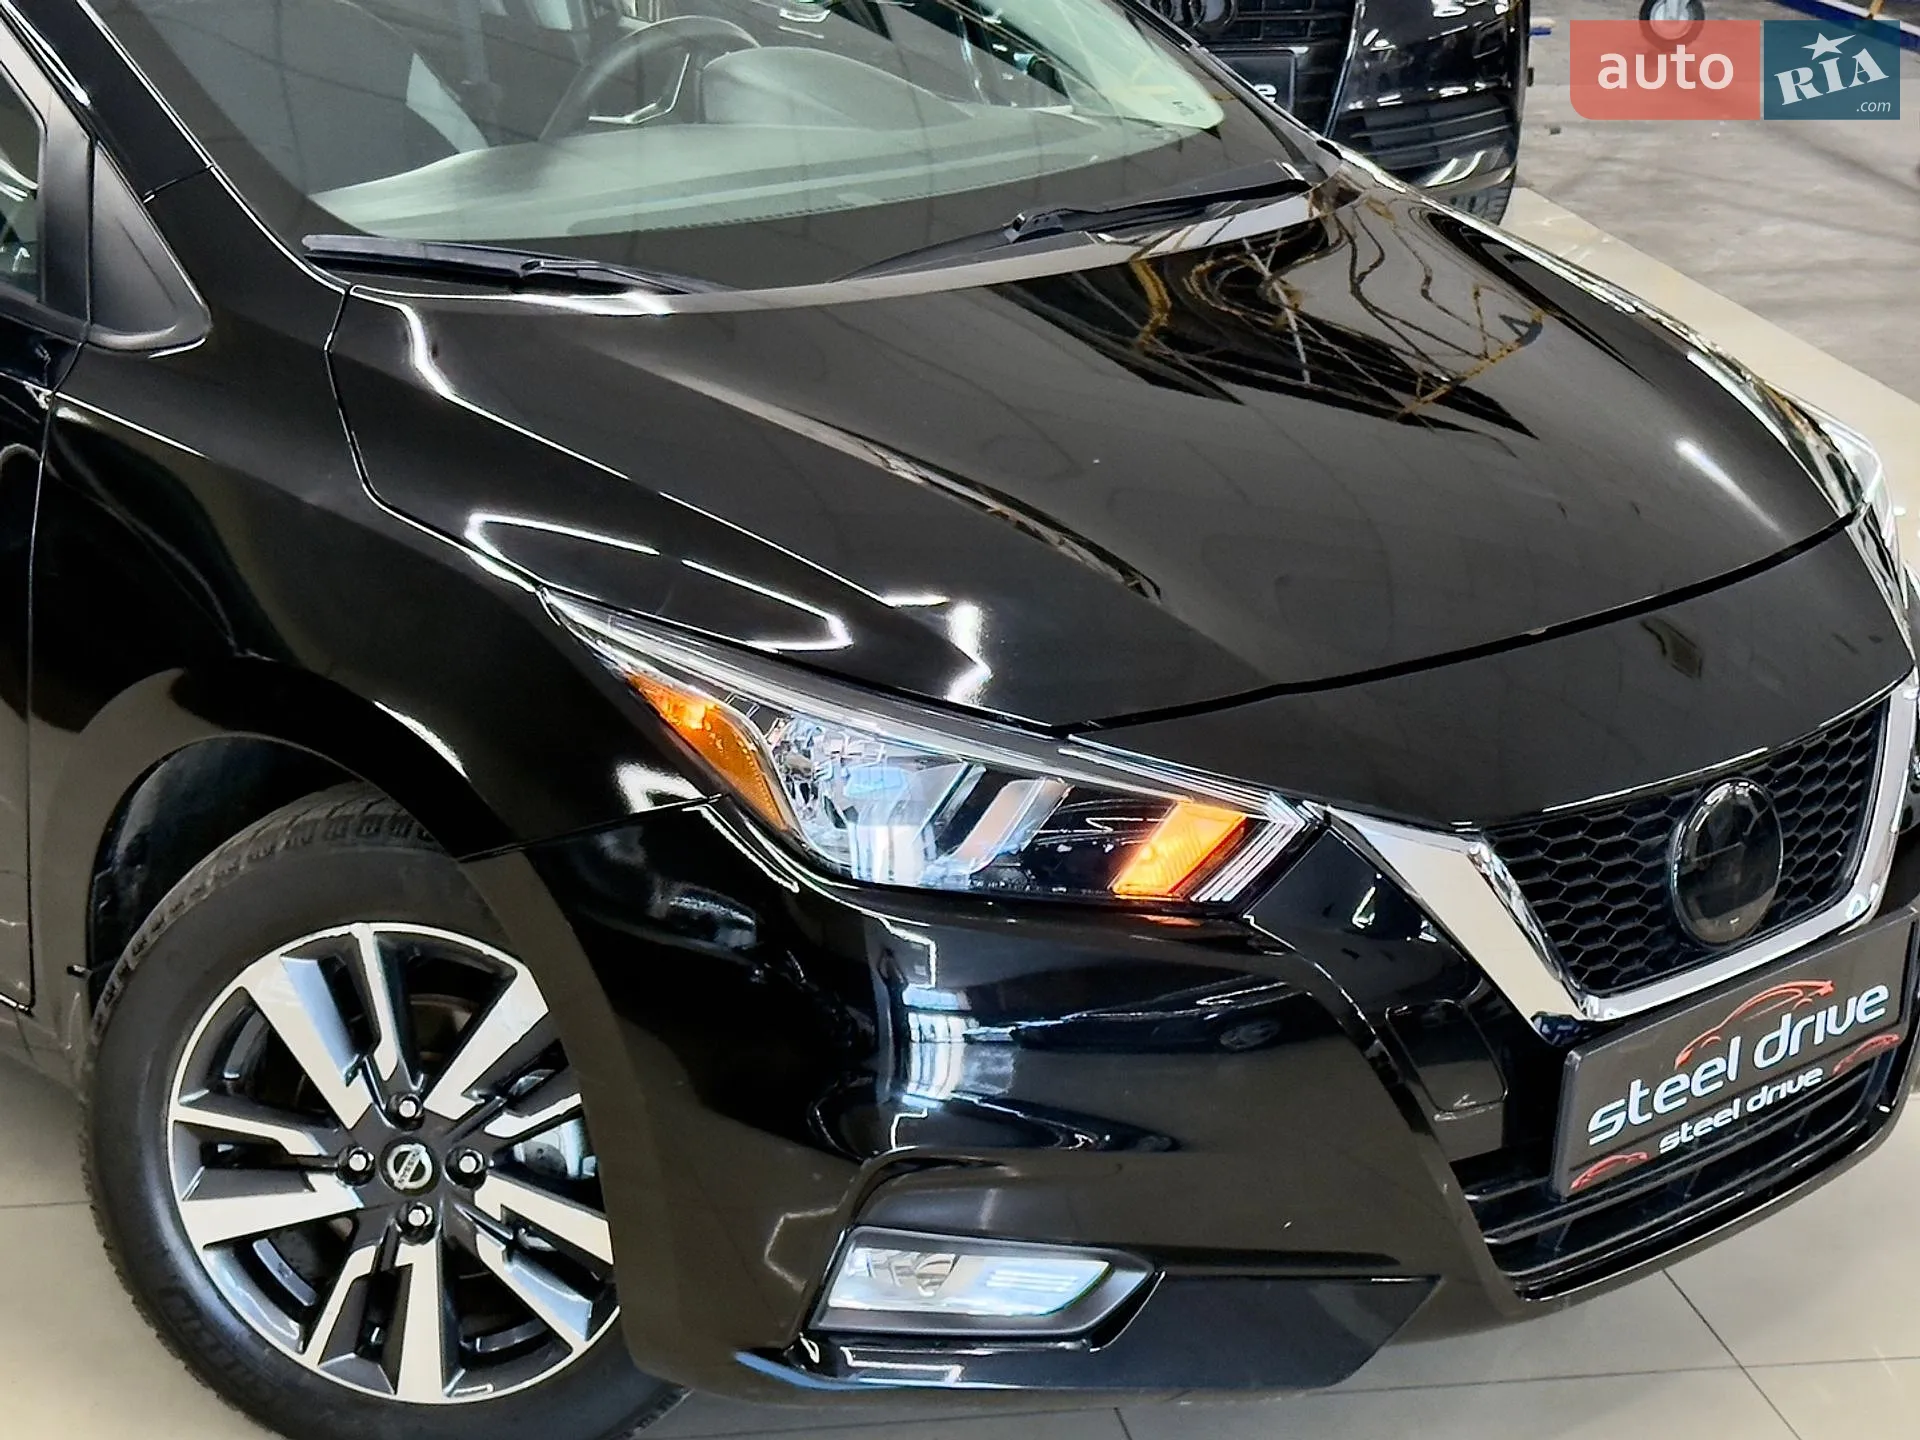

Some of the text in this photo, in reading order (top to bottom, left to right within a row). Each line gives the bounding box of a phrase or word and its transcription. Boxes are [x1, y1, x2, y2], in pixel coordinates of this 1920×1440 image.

[1587, 984, 1889, 1146] steel drive
[1658, 1067, 1824, 1154] steel drive
